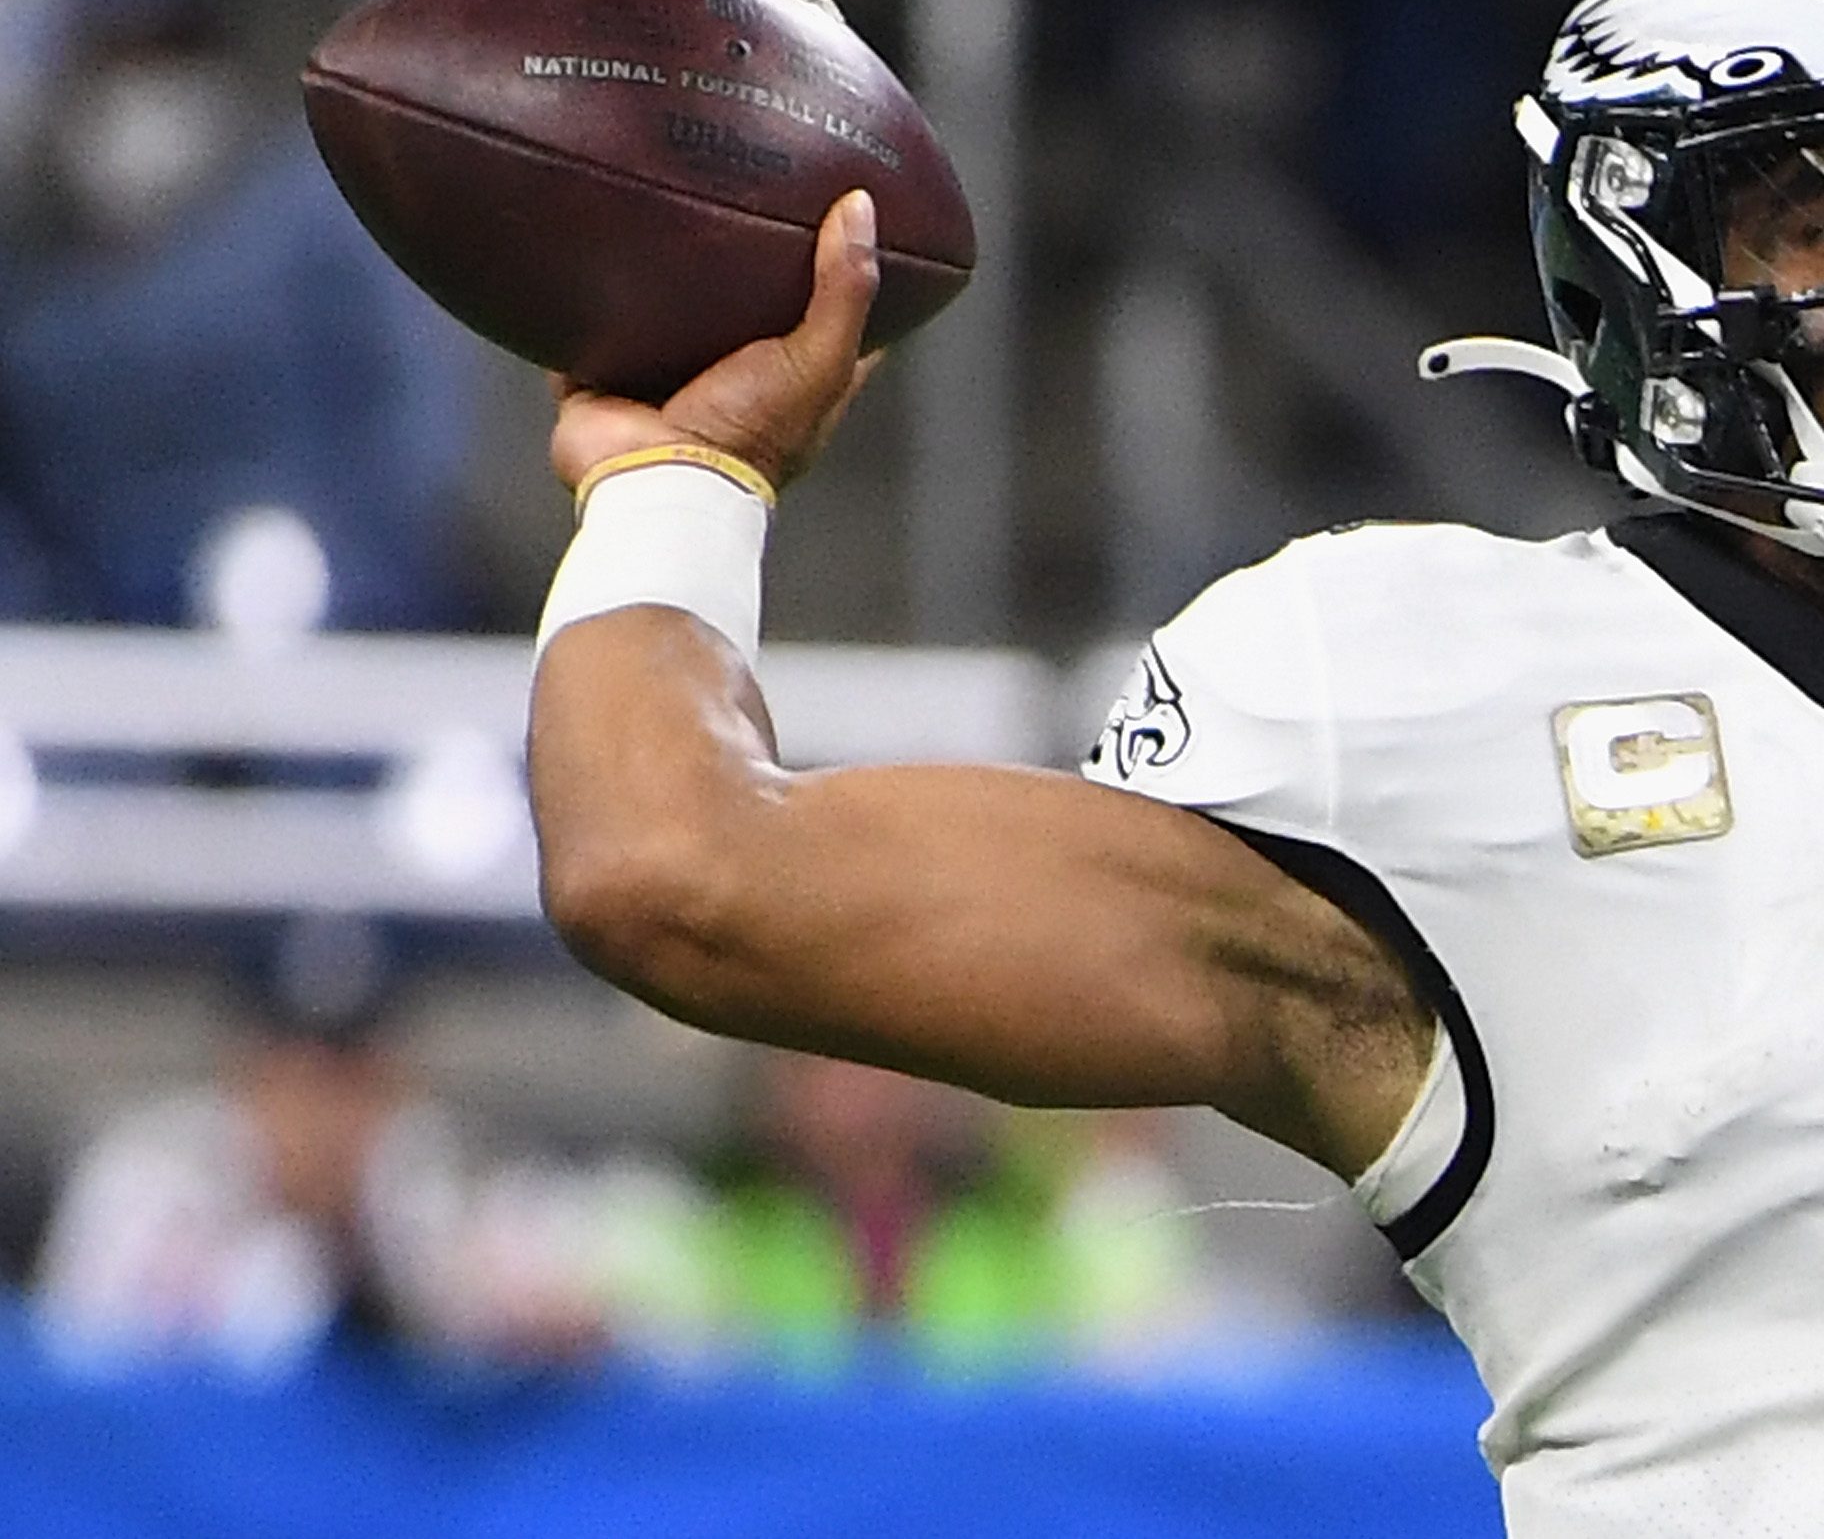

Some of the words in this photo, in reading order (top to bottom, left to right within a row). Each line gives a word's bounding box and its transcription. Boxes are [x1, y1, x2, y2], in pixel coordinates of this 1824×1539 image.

[523, 55, 667, 85] NATIONAL
[680, 69, 816, 125] FOOTBALL
[1567, 700, 1712, 810] C
